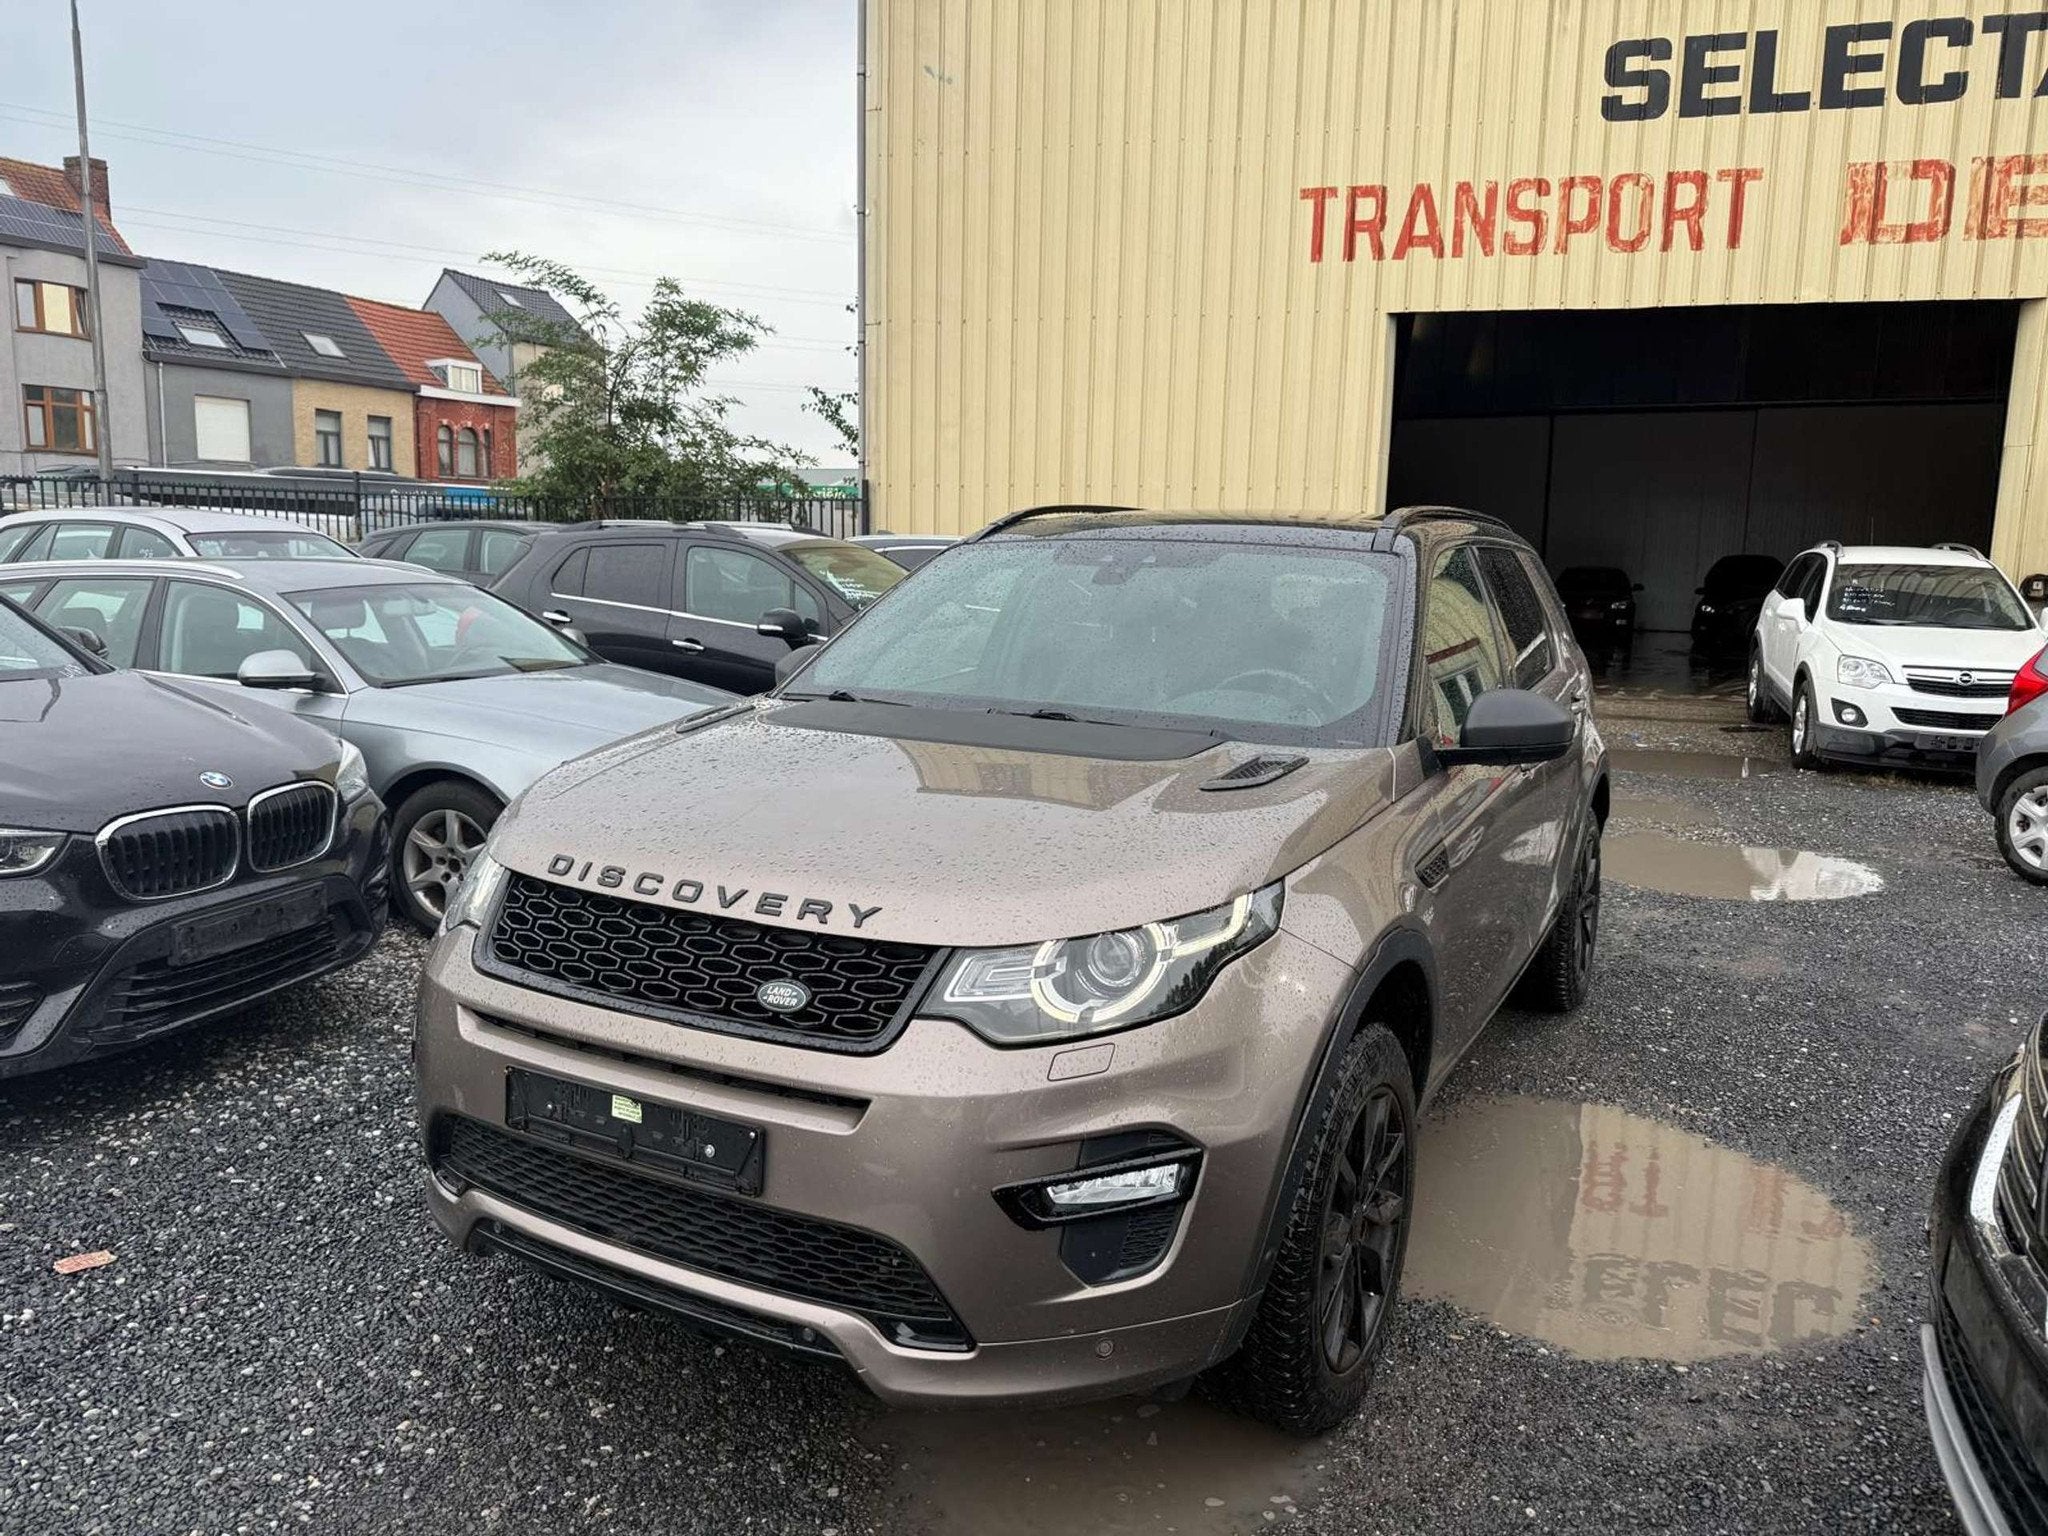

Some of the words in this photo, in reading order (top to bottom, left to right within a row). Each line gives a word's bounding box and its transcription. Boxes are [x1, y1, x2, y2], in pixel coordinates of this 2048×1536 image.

[1601, 12, 2048, 122] SELECT
[1300, 167, 1764, 263] TRANSPORT
[547, 853, 882, 928] DISCOVERY
